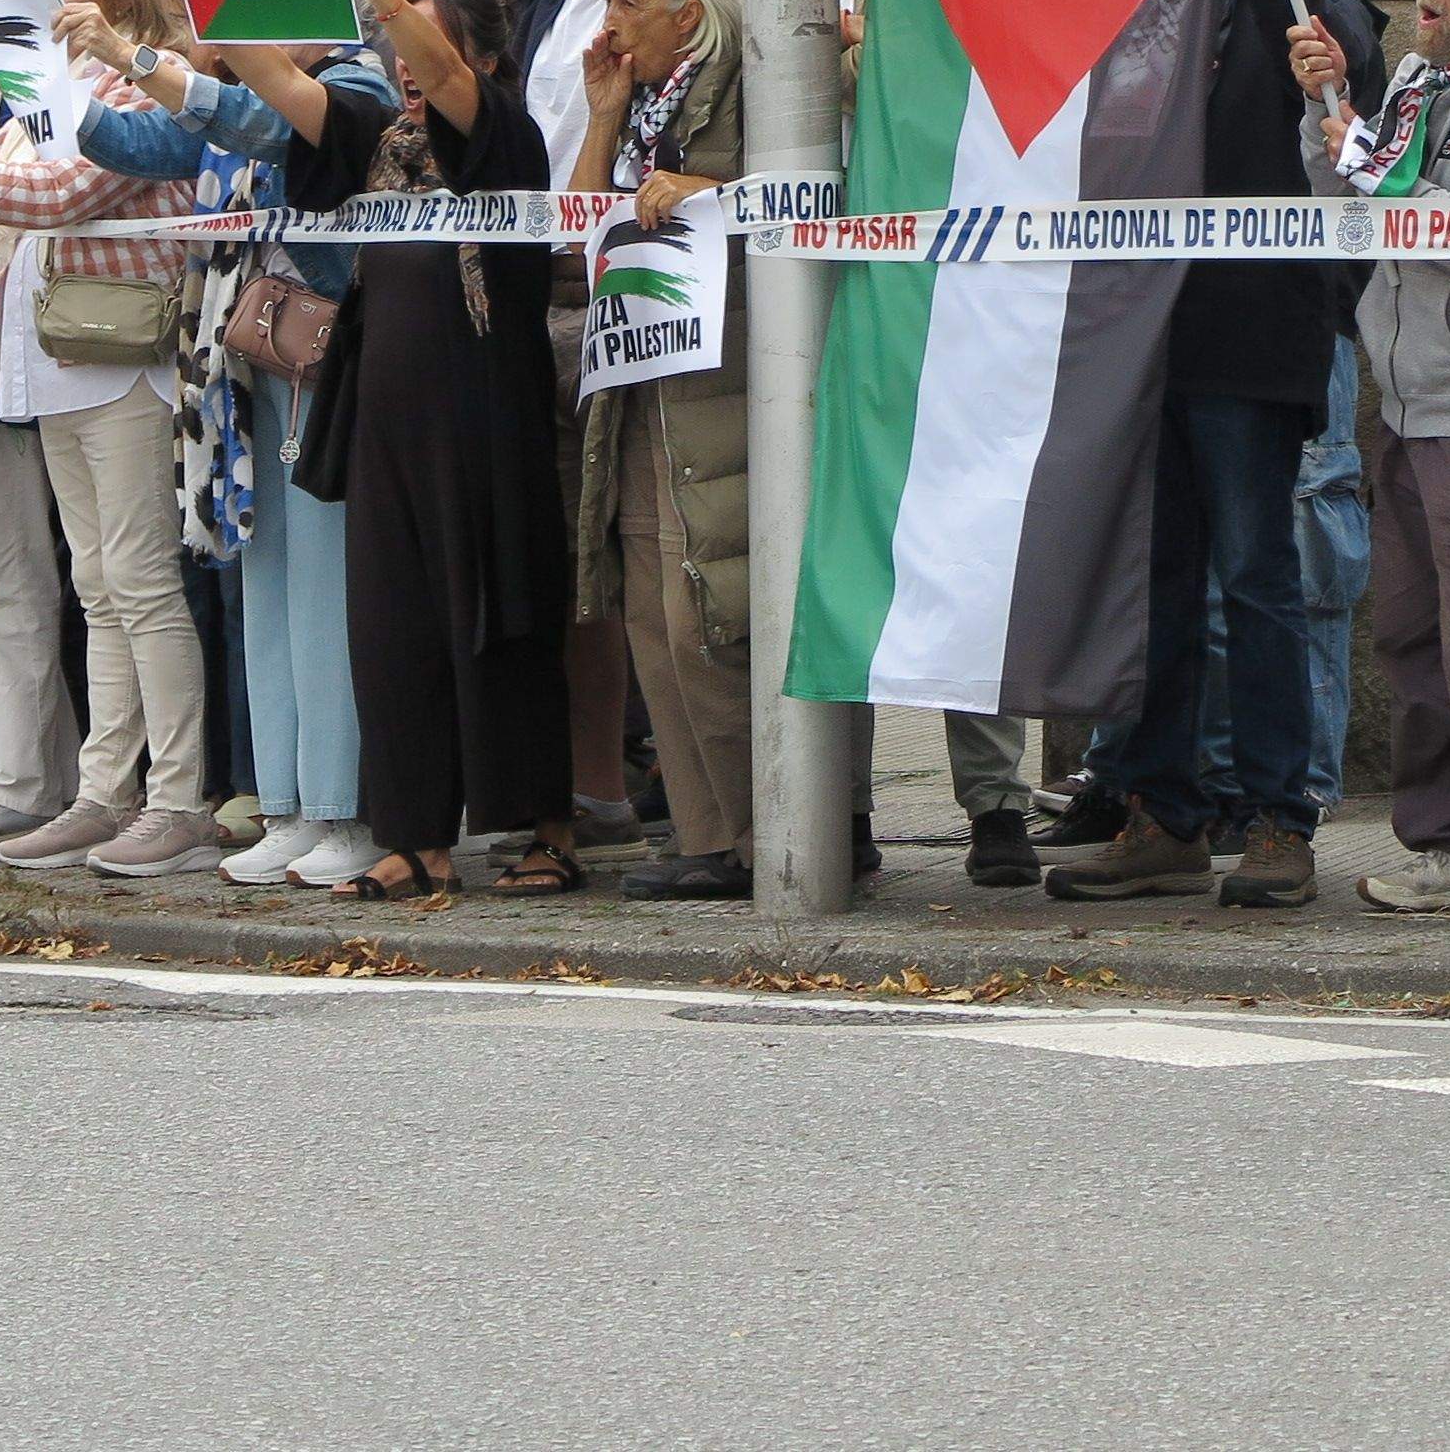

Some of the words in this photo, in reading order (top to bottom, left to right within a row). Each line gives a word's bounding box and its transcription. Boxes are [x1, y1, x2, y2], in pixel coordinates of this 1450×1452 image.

[411, 197, 442, 231] DE
[440, 194, 518, 232] POLICIA
[558, 194, 588, 231] NO
[735, 185, 755, 224] C.
[762, 181, 842, 222] NACION
[836, 215, 917, 251] PASAR
[1016, 211, 1040, 250] C.
[1049, 209, 1176, 250] NACIONAL
[1184, 209, 1216, 249] DE
[1225, 207, 1325, 248] POLICIA
[1382, 208, 1417, 250] NO
[604, 316, 702, 367] PALESTINA
